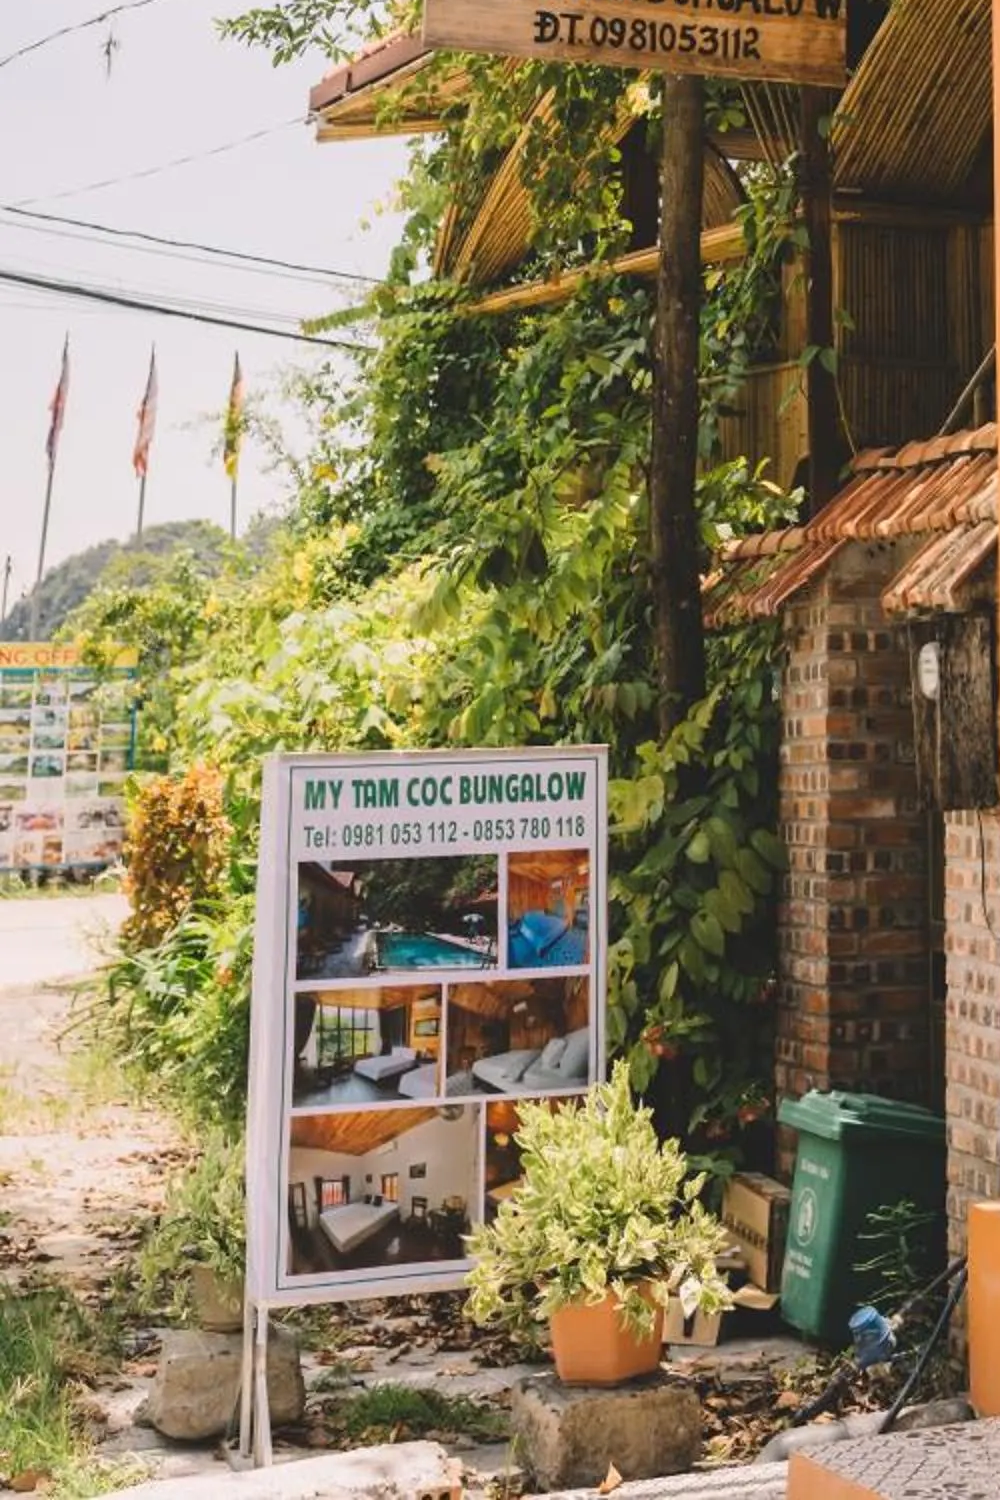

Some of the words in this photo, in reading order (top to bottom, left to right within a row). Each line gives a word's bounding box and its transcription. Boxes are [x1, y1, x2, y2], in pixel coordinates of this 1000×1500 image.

[303, 779, 343, 810] MY
[352, 778, 399, 809] TAM
[406, 776, 453, 807] COC
[459, 771, 587, 806] BUNGALOW
[303, 825, 337, 848] Tel:
[342, 822, 383, 846] 0981
[390, 822, 422, 844] 053
[429, 821, 457, 843] 112
[473, 818, 514, 841] 0853
[519, 817, 550, 840] 780
[555, 815, 585, 838] 118
